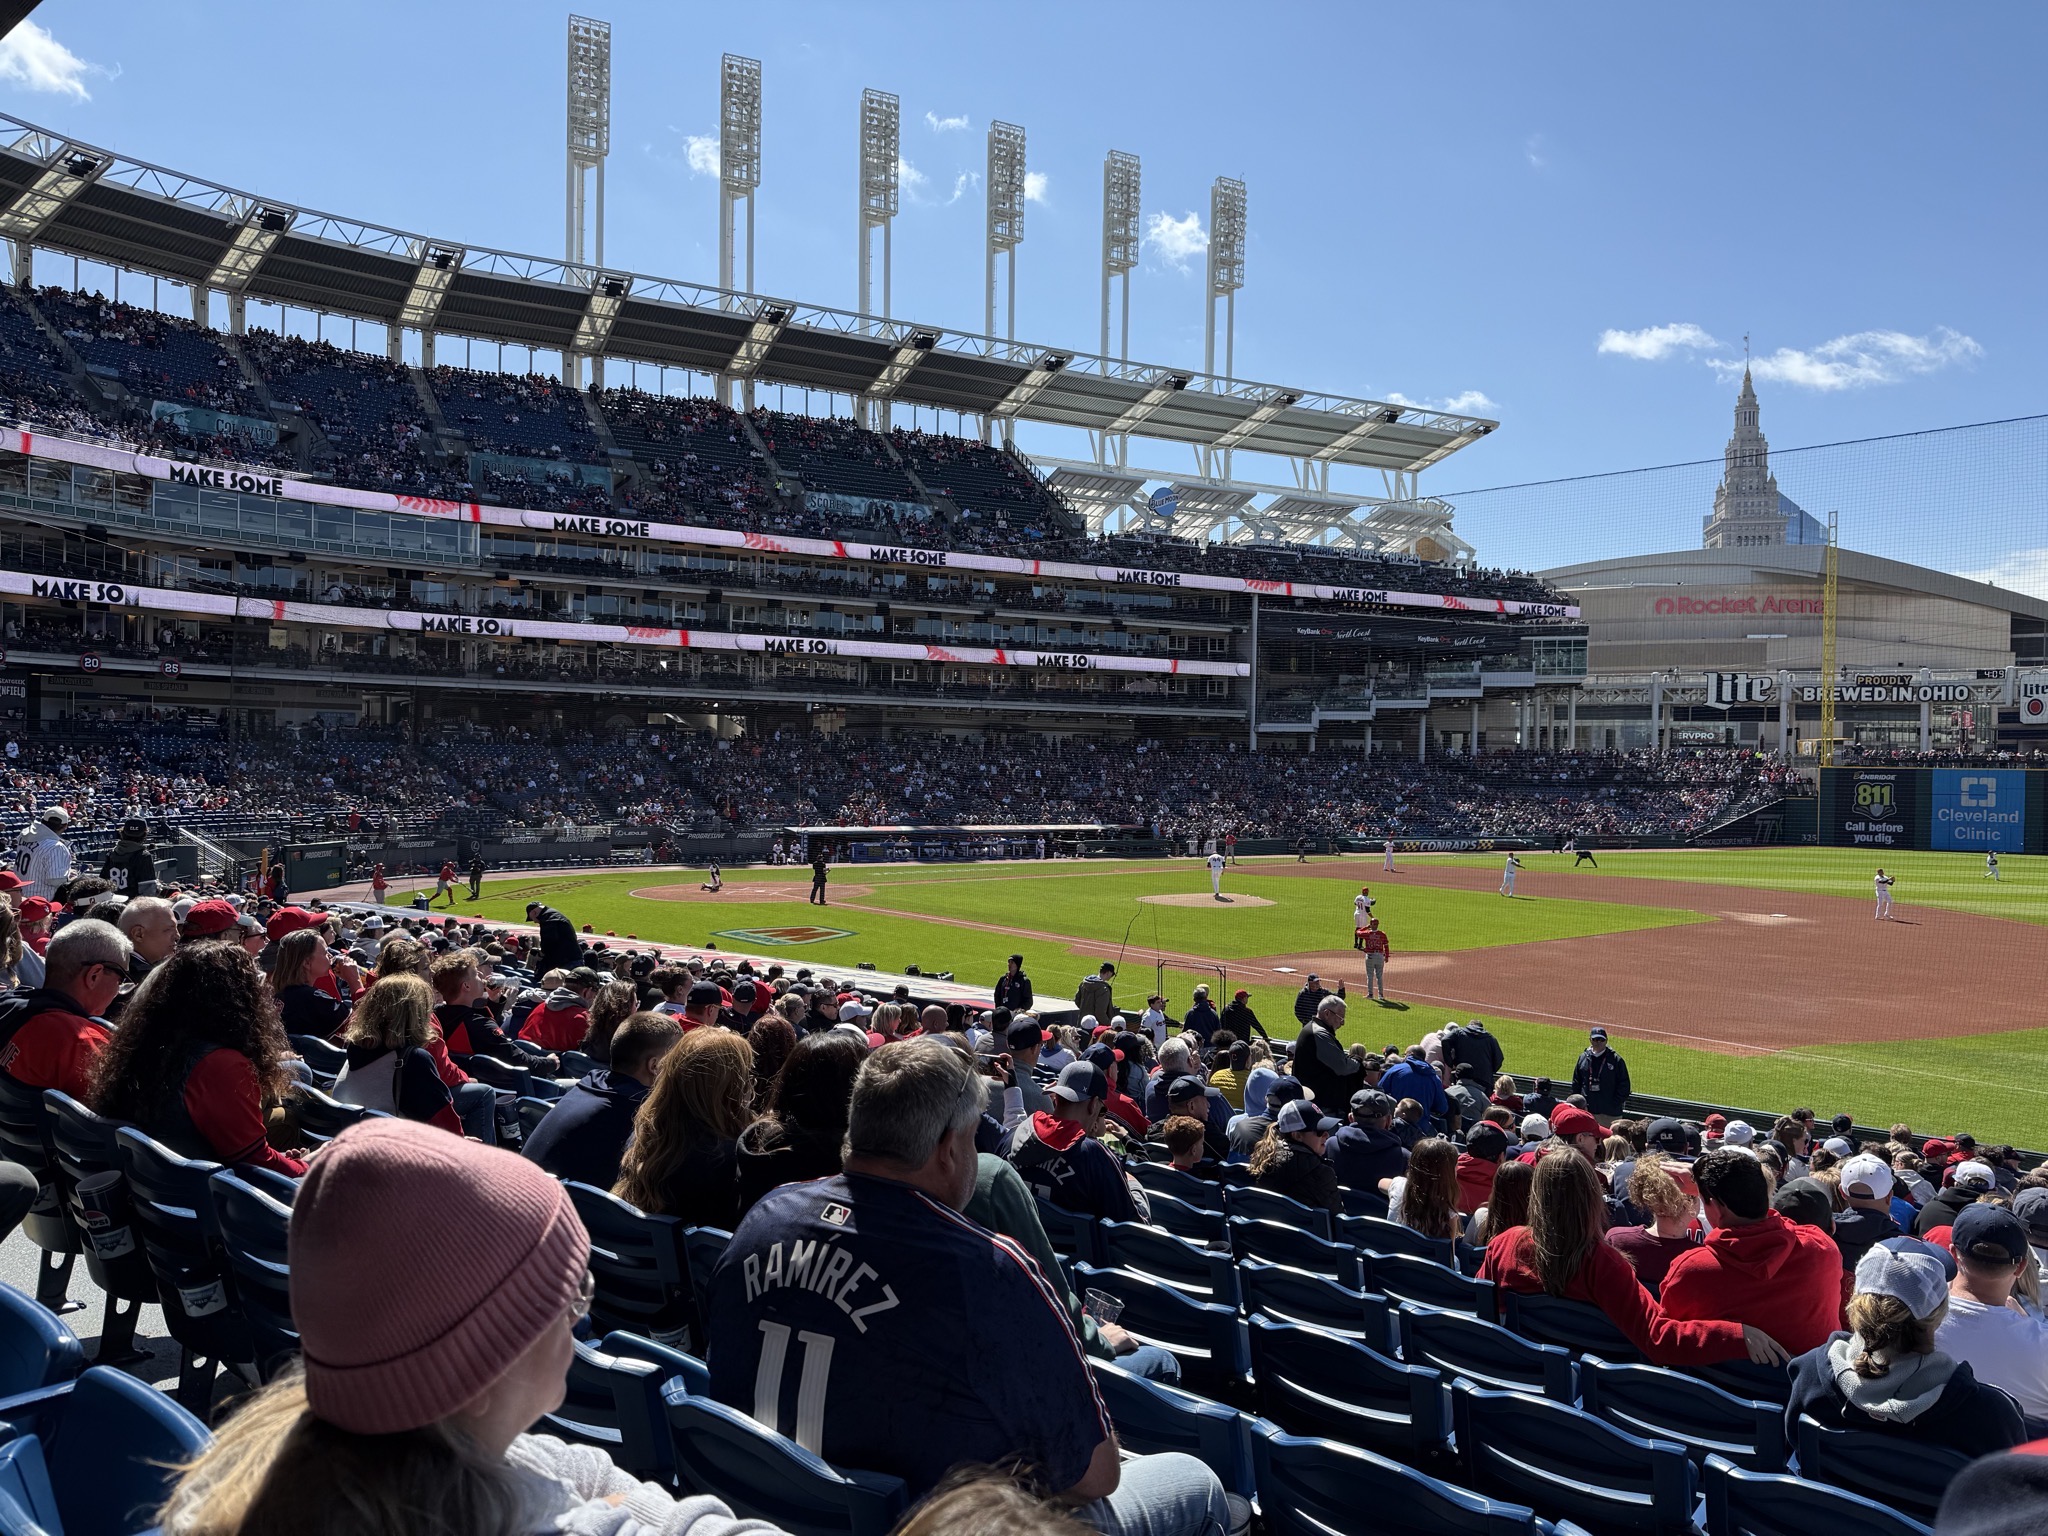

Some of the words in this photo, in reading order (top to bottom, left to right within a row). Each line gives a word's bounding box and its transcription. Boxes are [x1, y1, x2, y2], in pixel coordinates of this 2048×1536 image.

[216, 418, 273, 442] COLAVITO
[480, 459, 534, 476] ROBINSON
[170, 464, 225, 488] MAKE
[230, 473, 283, 496] SOME
[1149, 498, 1164, 508] BLUE
[1164, 495, 1179, 504] MOON
[553, 516, 600, 533] MAKE
[604, 521, 650, 537] SOME
[870, 547, 907, 562] MAKE
[910, 551, 947, 566] SOME
[1117, 570, 1148, 584] MAKE
[1150, 572, 1181, 586] SOME
[32, 578, 91, 601] MAKE
[1332, 590, 1360, 601] MAKE
[1361, 591, 1388, 603] SOME
[1519, 604, 1542, 615] MAKE
[1543, 605, 1567, 617] SOME
[1677, 596, 1757, 614] Rocket
[1761, 595, 1825, 613] Arena
[421, 615, 472, 633] MAKE
[1296, 627, 1320, 635] KeyBank
[765, 638, 804, 653] MAKE
[84, 657, 99, 668] 20
[1037, 654, 1069, 667] MAKE
[164, 663, 179, 674] 25
[1984, 670, 2005, 679] 4:09
[1857, 675, 1911, 685] PROUDLY
[1703, 672, 1773, 711] Lite
[1891, 686, 1914, 702] IN
[1918, 685, 1969, 702] OHIO
[1859, 773, 1897, 781] ENBRIDGE
[1857, 784, 1891, 806] 811
[1937, 808, 2019, 824] Cleveland
[1845, 821, 1866, 832] Call
[1868, 822, 1904, 833] before
[1954, 826, 2001, 841] Clinic
[397, 841, 436, 849] PROGRESSIVE
[501, 836, 542, 845] PROGRESSIVE
[1801, 834, 1818, 842] 325
[1854, 834, 1874, 844] you
[1874, 833, 1895, 845] dig.
[1419, 840, 1478, 852] CONRAD'S
[304, 850, 333, 859] PROGRESSIVE
[15, 850, 31, 875] 40
[326, 871, 342, 880] et365
[743, 1232, 900, 1335] RAMÍREZ
[752, 1318, 836, 1458] 11
